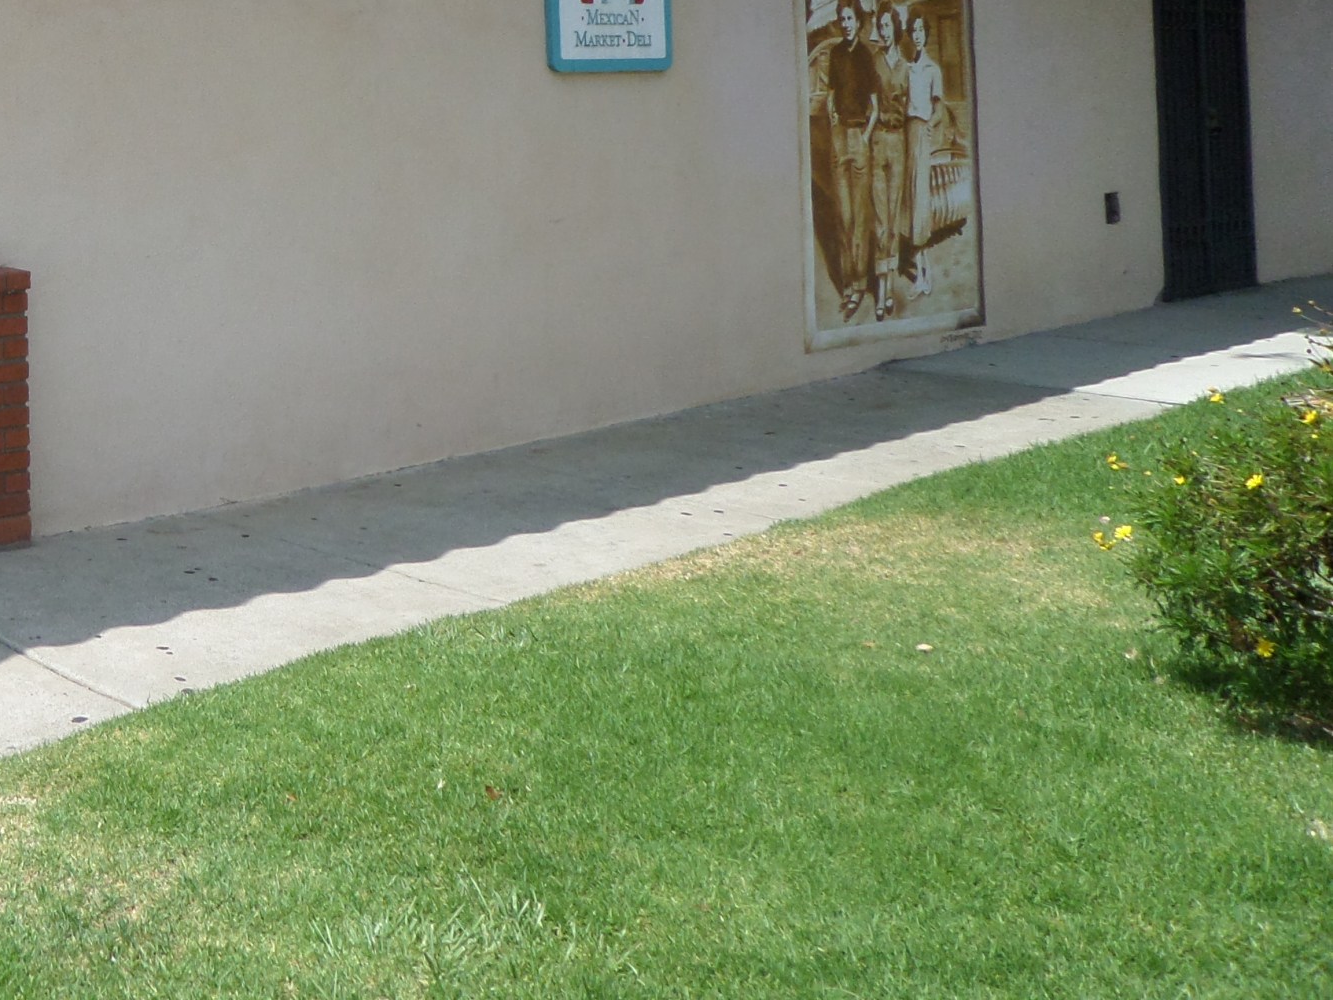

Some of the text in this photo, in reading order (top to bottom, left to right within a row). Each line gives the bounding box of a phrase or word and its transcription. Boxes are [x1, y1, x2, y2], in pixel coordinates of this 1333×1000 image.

[586, 8, 640, 27] MEXICAN
[574, 30, 652, 49] MARKET DELI
